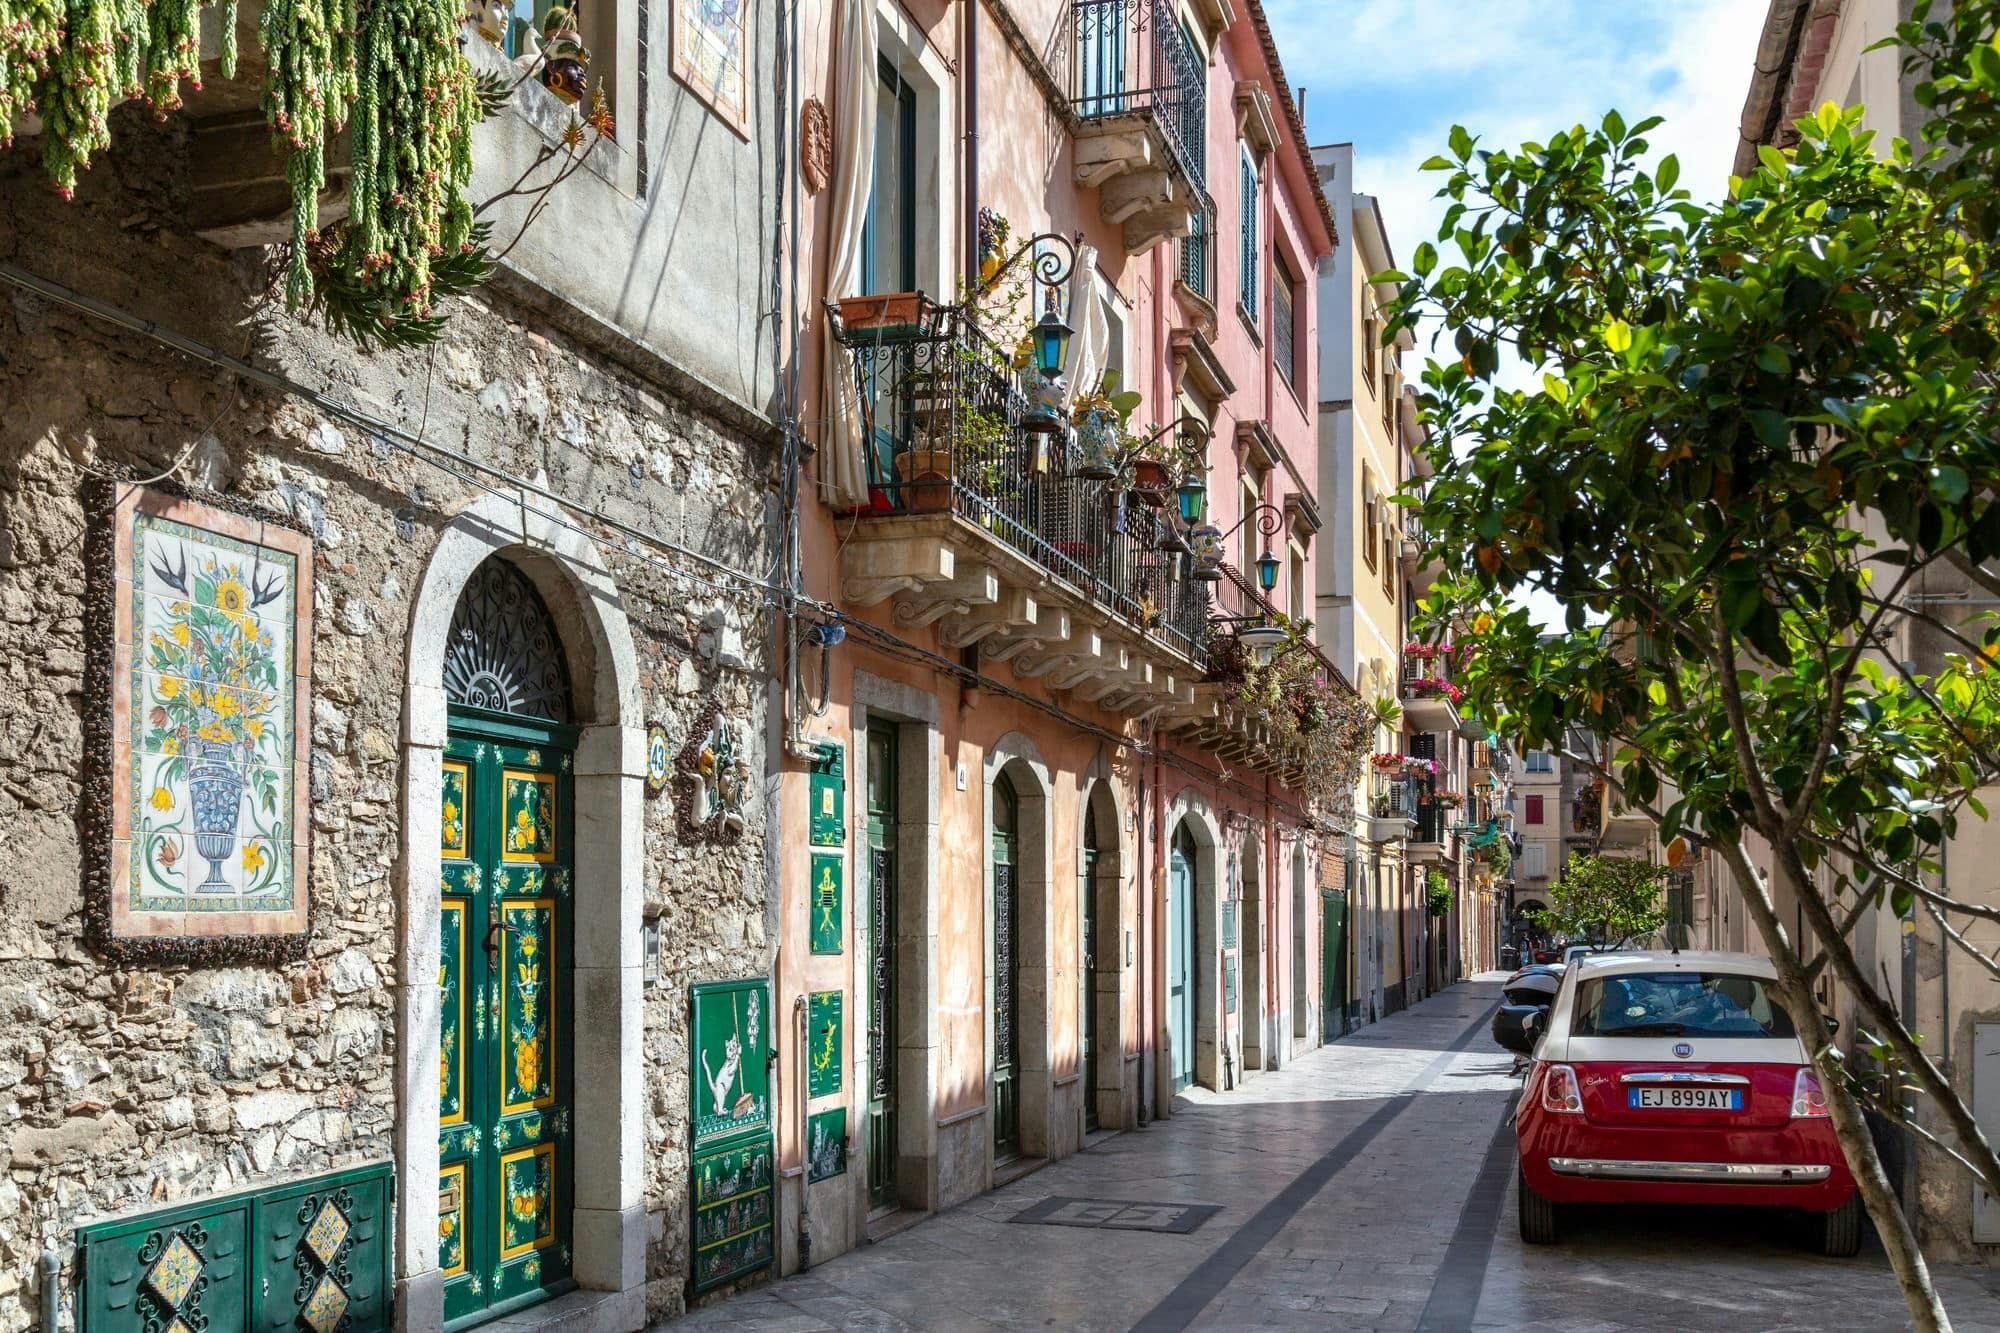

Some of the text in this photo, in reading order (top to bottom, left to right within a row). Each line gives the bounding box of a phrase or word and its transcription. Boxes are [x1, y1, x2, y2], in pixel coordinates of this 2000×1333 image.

[652, 743, 664, 771] 43
[1641, 1090, 1729, 1108] EJ 899AY
